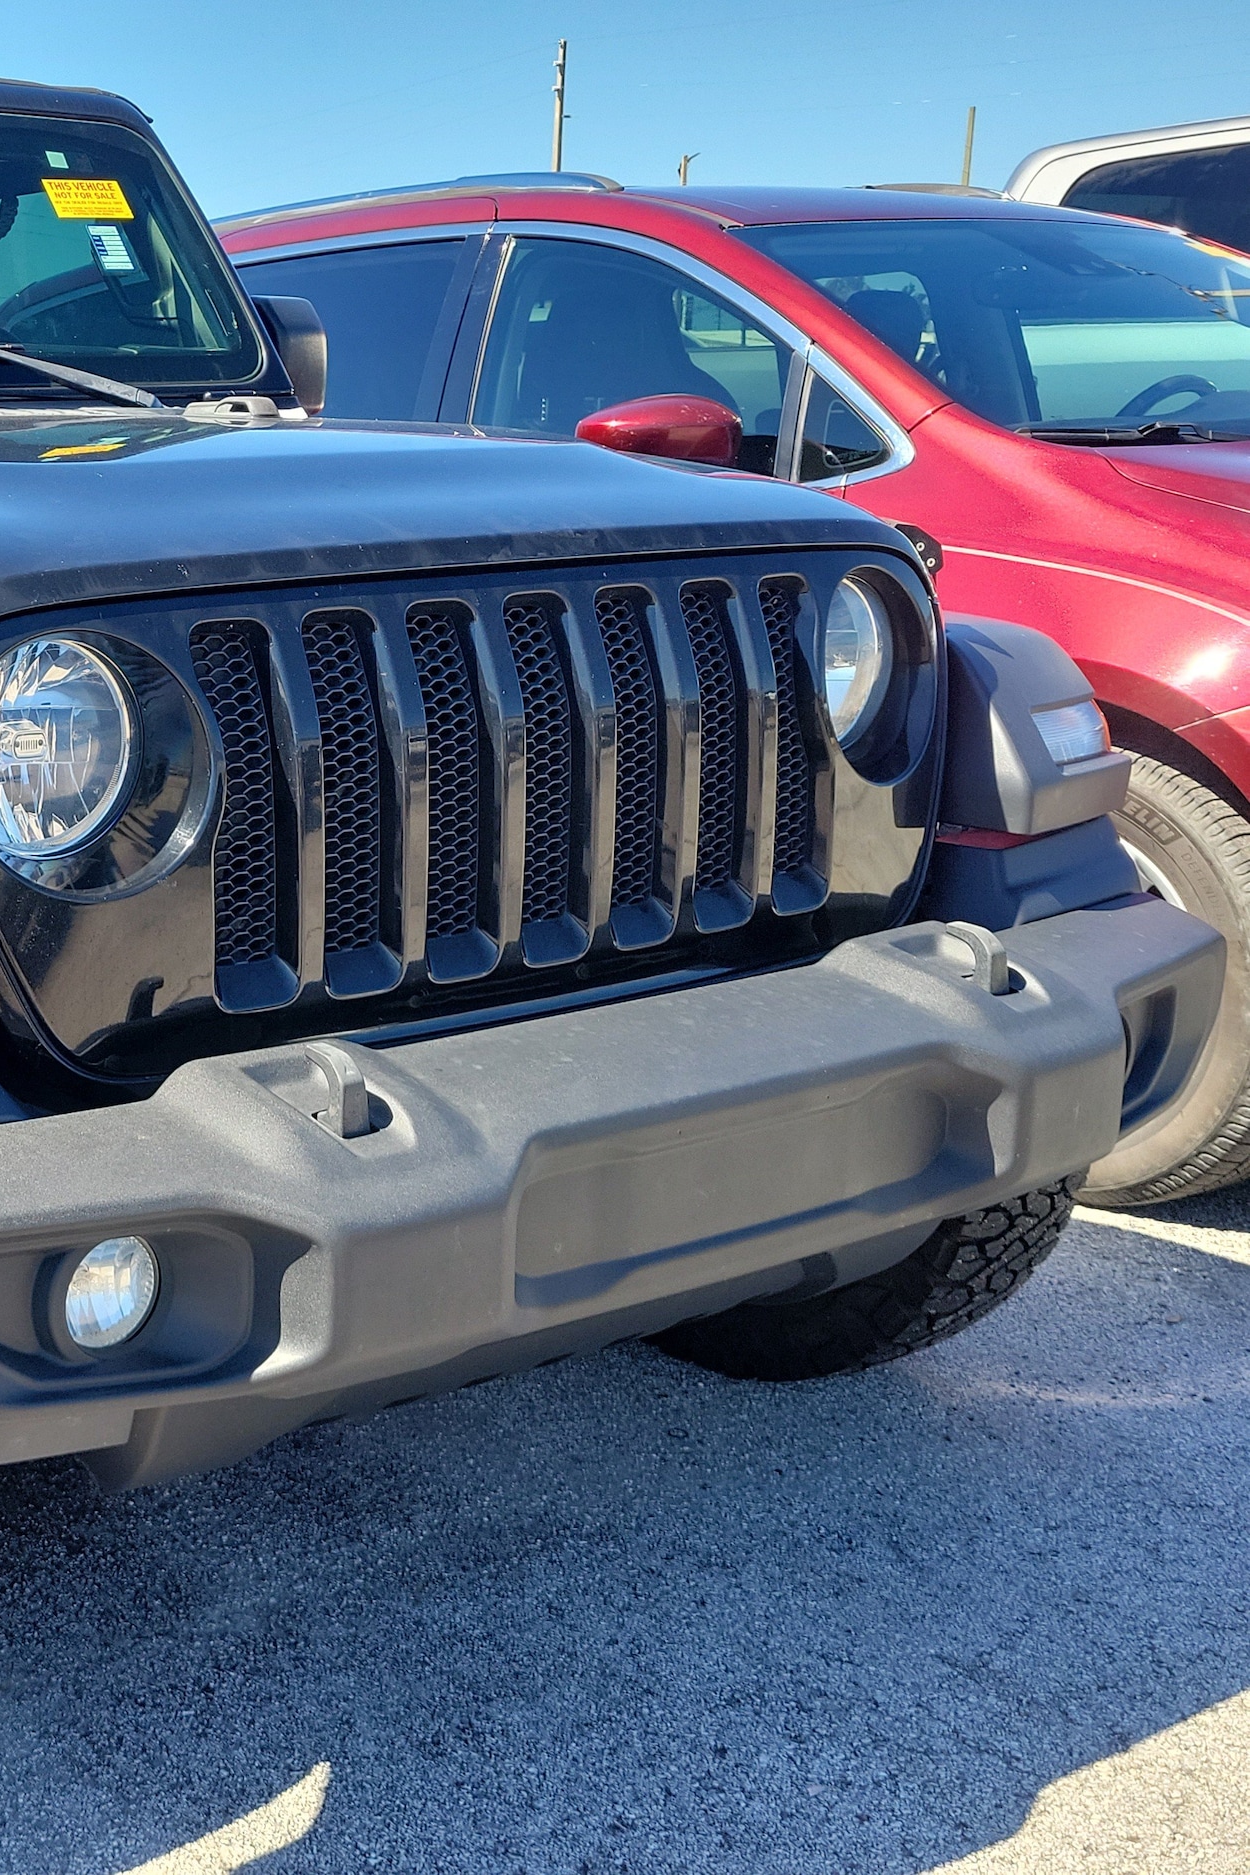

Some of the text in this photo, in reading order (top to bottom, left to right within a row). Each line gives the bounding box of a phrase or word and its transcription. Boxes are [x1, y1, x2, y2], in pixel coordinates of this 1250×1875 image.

[47, 181, 115, 192] THIS VEHICLE
[94, 192, 117, 200] SALE
[1122, 800, 1176, 842] ELIN
